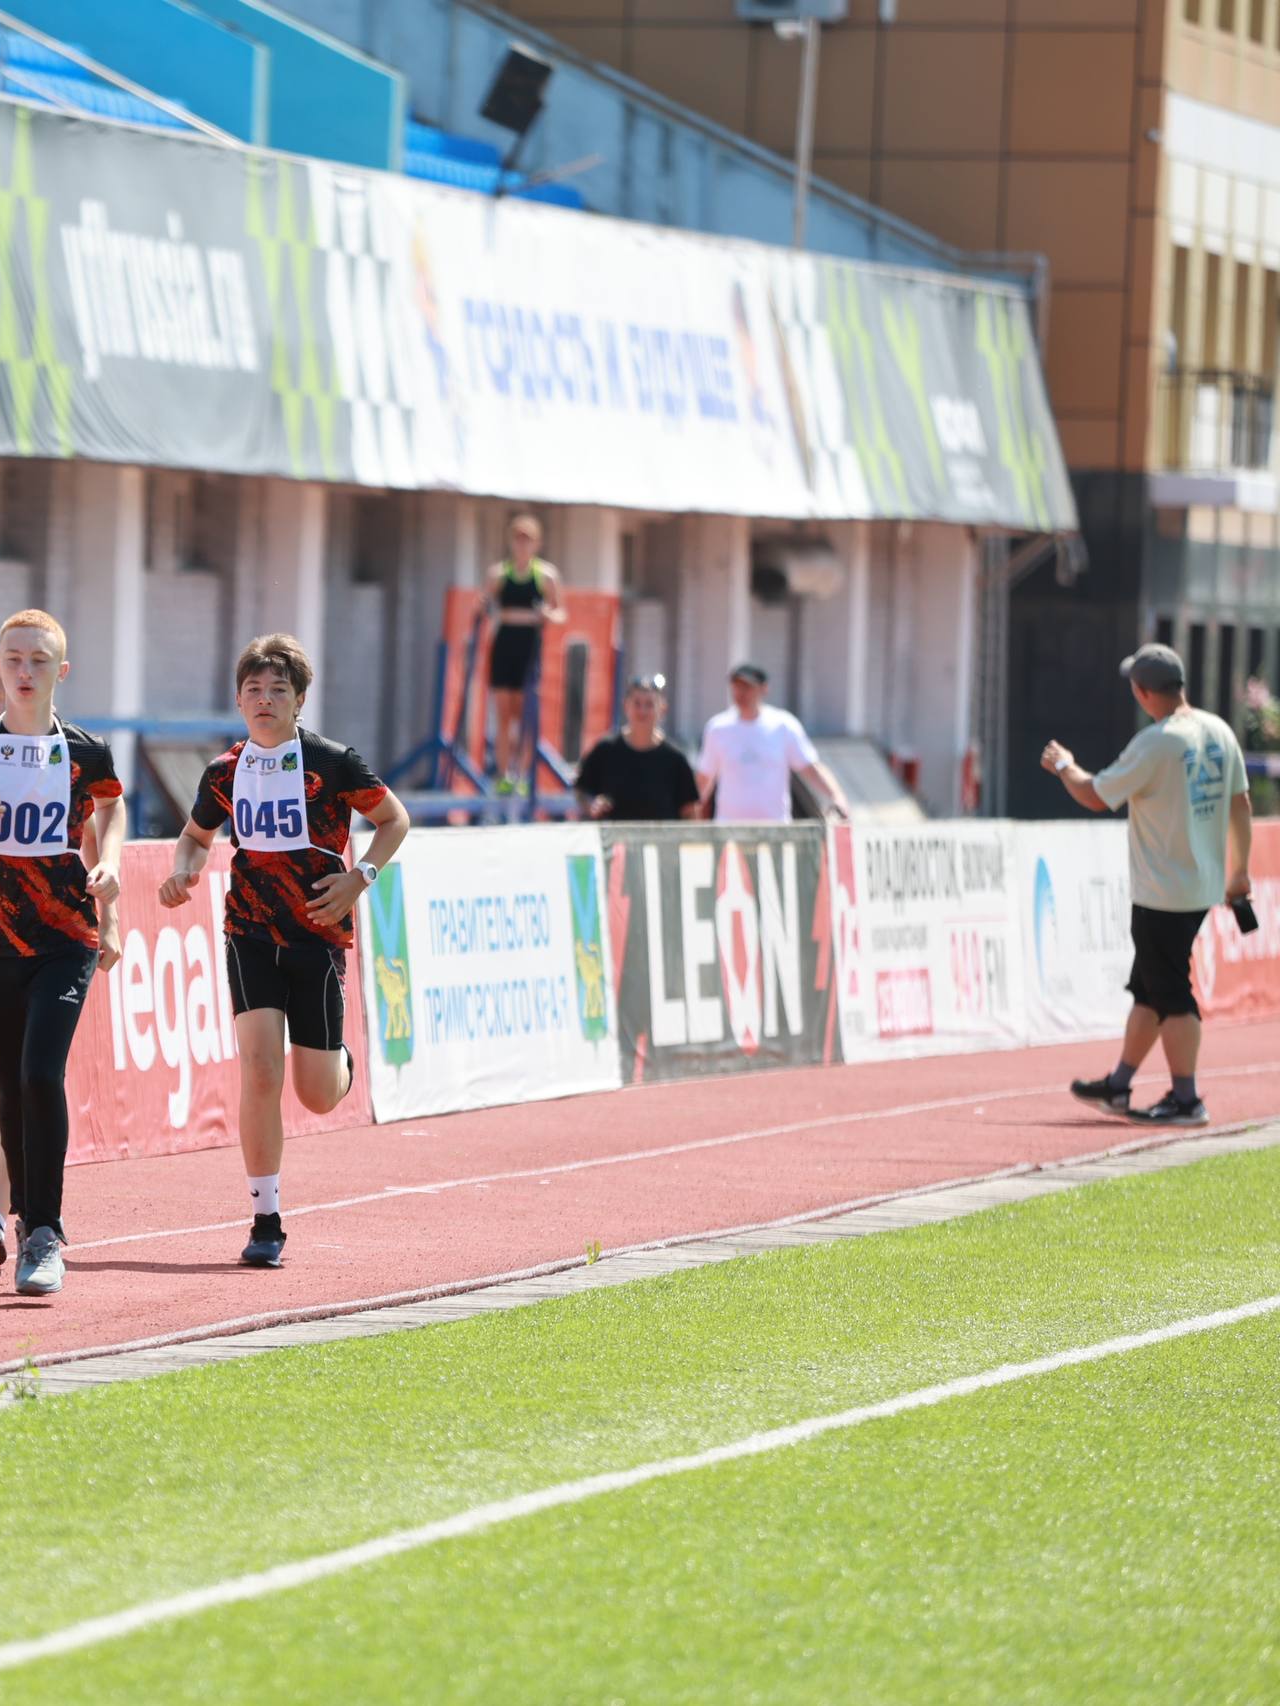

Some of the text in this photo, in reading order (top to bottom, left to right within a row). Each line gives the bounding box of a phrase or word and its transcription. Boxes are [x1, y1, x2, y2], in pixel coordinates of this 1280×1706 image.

[236, 797, 303, 839] 045
[429, 893, 550, 955] ПРАВИТЕЛЬСТВО
[642, 841, 804, 1047] LEON
[424, 979, 532, 1043] ПРИМОРСКОГО
